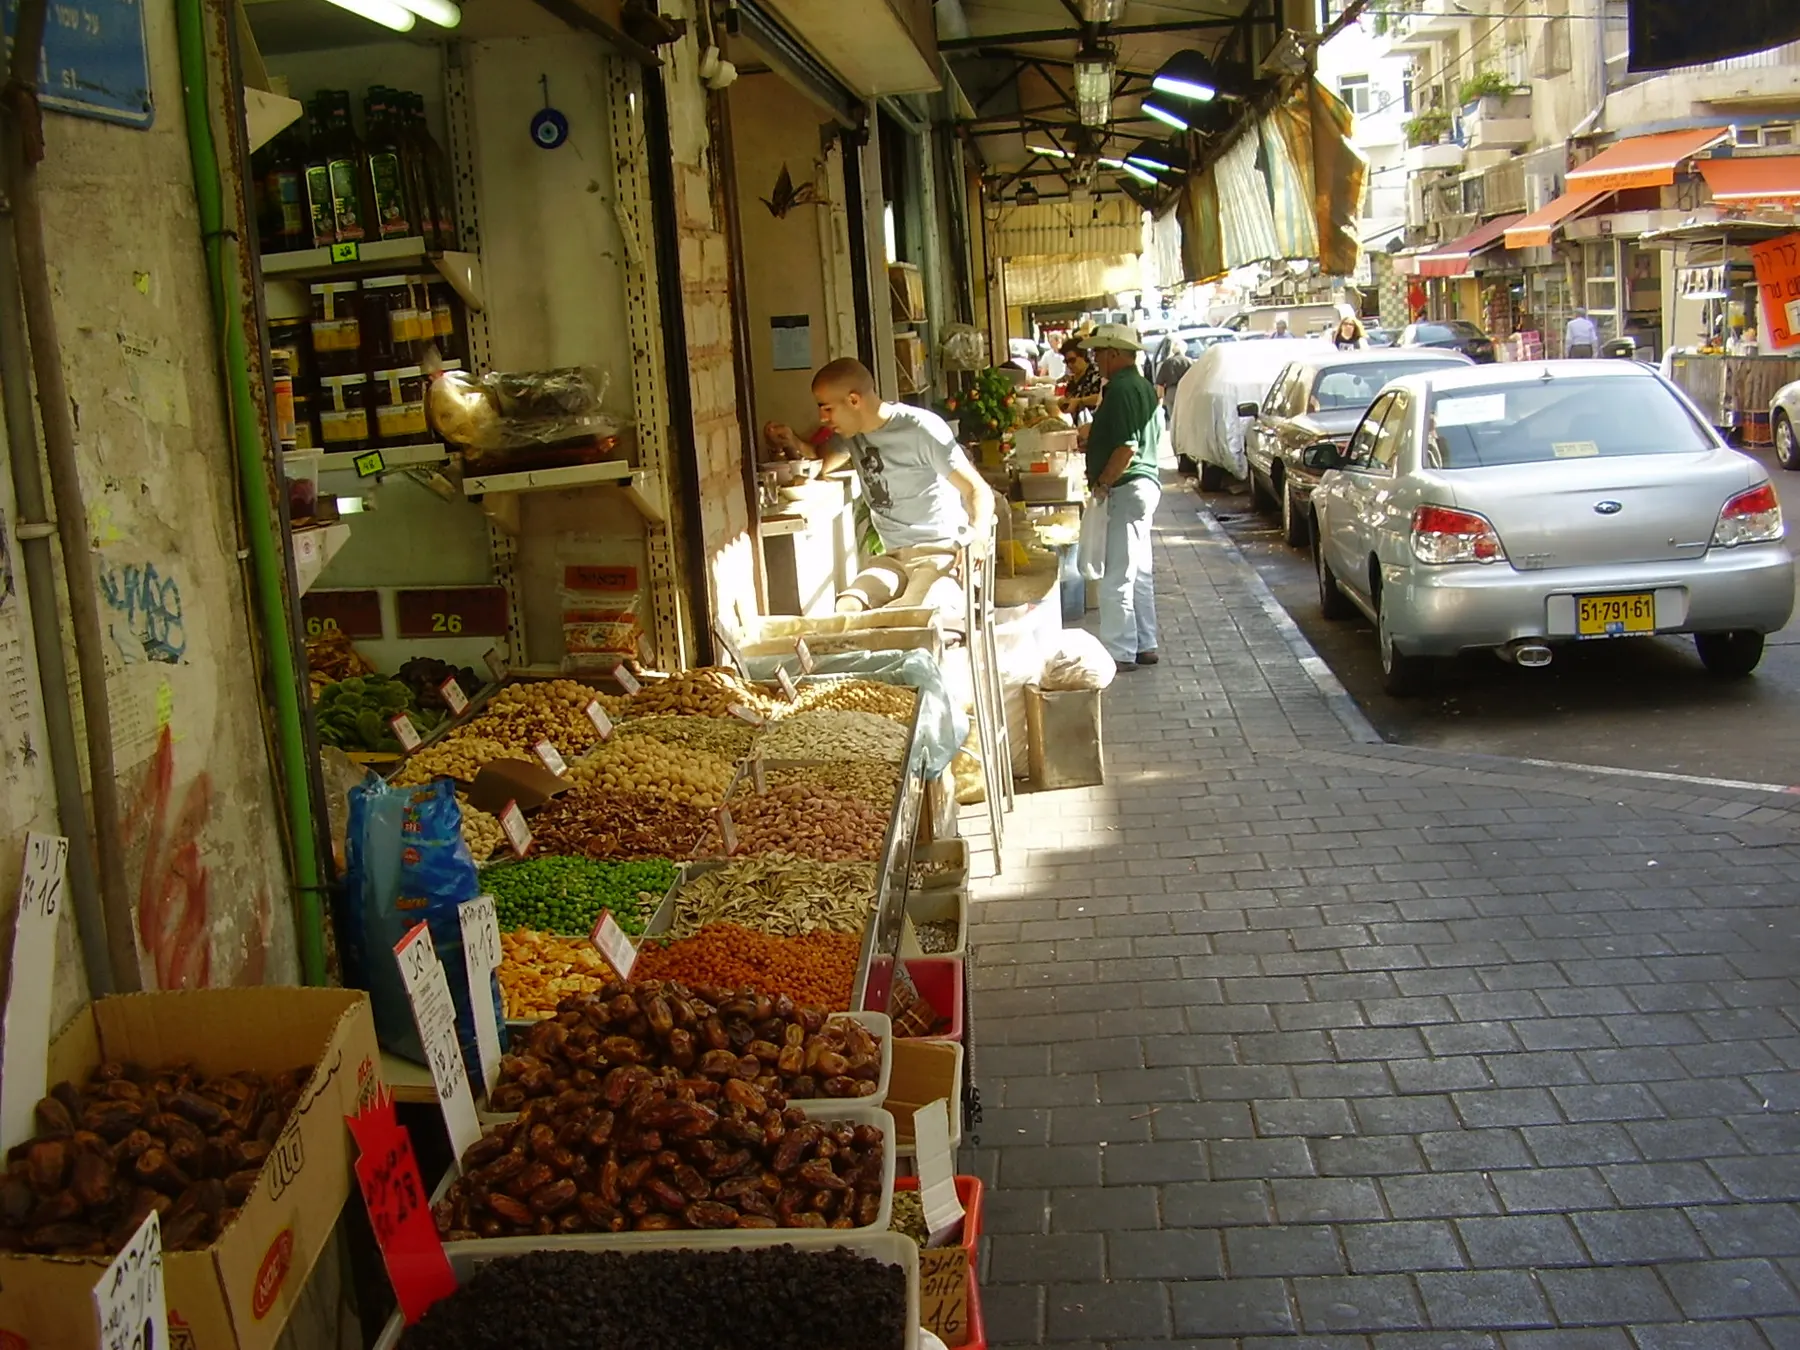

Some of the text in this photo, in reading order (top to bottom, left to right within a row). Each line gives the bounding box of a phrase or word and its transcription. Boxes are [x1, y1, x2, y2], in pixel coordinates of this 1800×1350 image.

[62, 68, 82, 90] st.
[1581, 600, 1651, 622] 51-791-61
[306, 616, 337, 636] 60
[430, 613, 461, 633] 26
[38, 877, 60, 917] 16
[928, 1299, 961, 1336] 16
